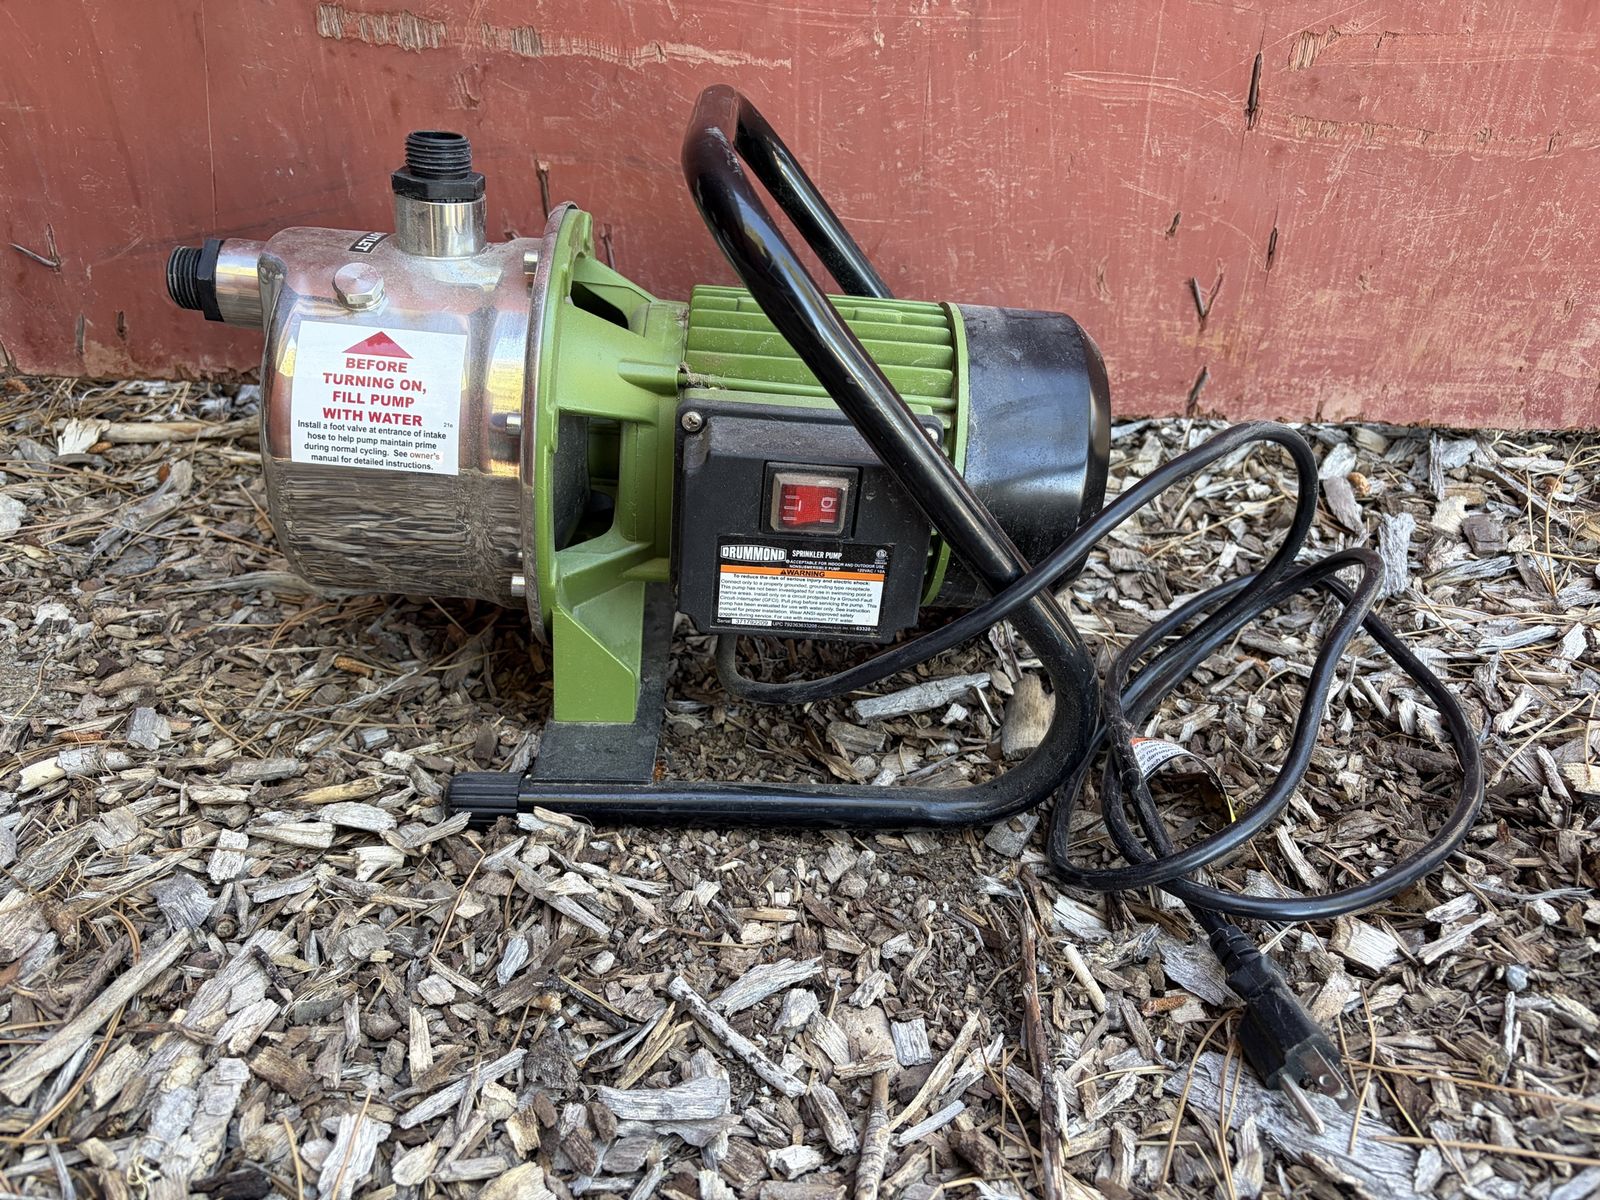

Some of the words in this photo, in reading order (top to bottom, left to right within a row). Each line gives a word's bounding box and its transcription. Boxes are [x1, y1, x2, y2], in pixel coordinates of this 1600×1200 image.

[345, 357, 407, 373] BEFORE
[322, 372, 394, 389] TURNING
[399, 379, 426, 394] ON,
[332, 390, 365, 404] FILL
[370, 393, 414, 408] PUMP
[322, 407, 363, 421] WITH
[367, 411, 423, 426] WATER
[297, 419, 321, 428] Install
[329, 422, 345, 430] foot
[346, 423, 367, 432] valve
[378, 427, 411, 436] entrance
[423, 430, 446, 439] intake
[307, 431, 326, 440] hose
[337, 434, 354, 444] help
[356, 437, 377, 446] pump
[380, 437, 412, 447] maintain
[414, 440, 436, 450] prime
[303, 442, 329, 452] during
[331, 444, 357, 453] normal
[359, 446, 389, 457] cycling.
[393, 449, 407, 457] See
[409, 450, 440, 460] owner's
[311, 453, 339, 462] manual
[353, 456, 383, 466] detailed
[385, 459, 433, 470] instructions.
[722, 546, 784, 561] DRUMMOND
[791, 549, 824, 558] SPRINKLER
